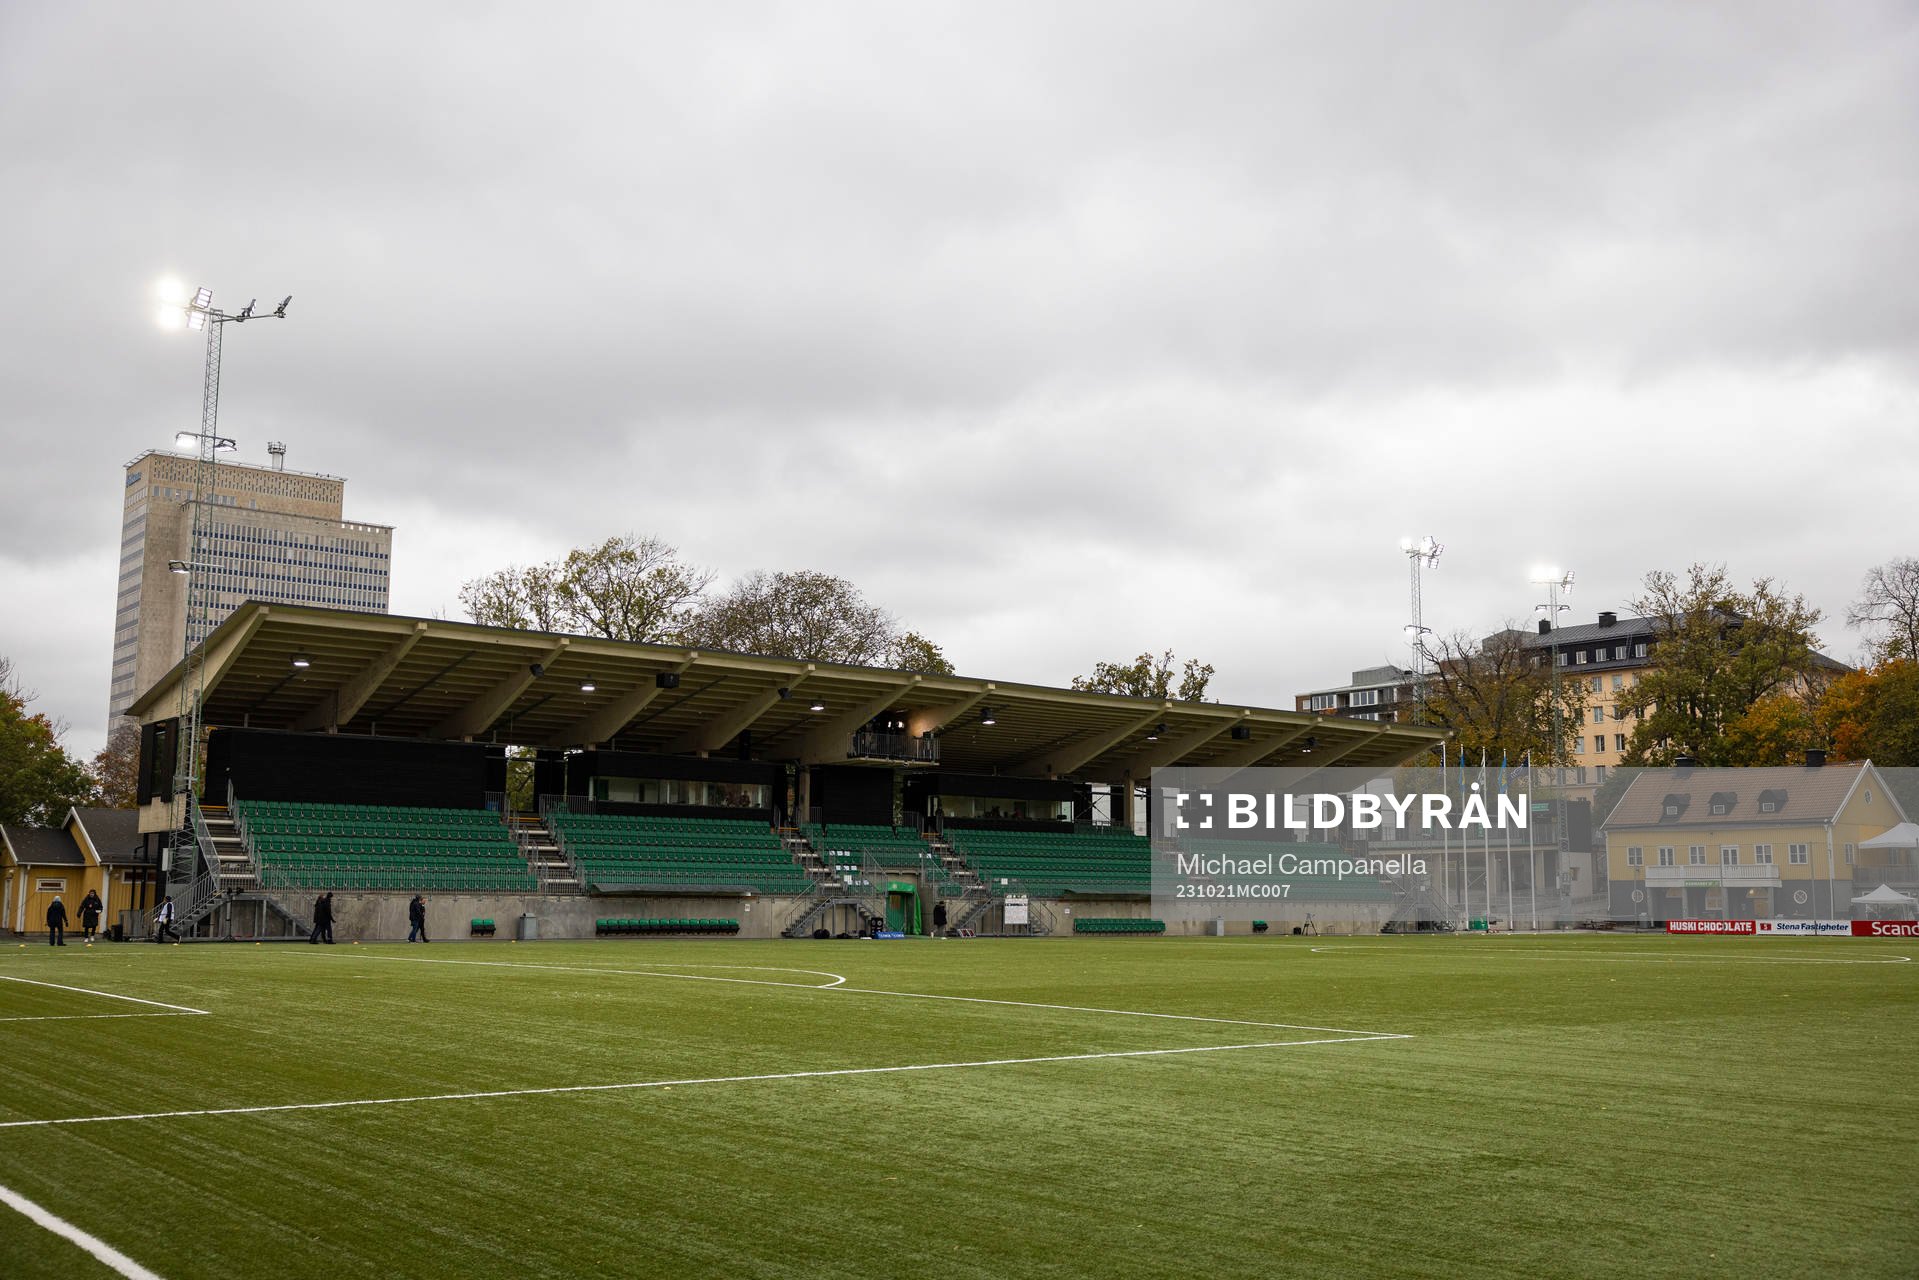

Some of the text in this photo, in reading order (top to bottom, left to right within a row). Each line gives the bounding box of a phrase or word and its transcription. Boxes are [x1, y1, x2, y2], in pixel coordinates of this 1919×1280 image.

[1670, 921, 1753, 932] HUSKI CHOCOLATE
[1776, 922, 1849, 932] Stena Fastigheter
